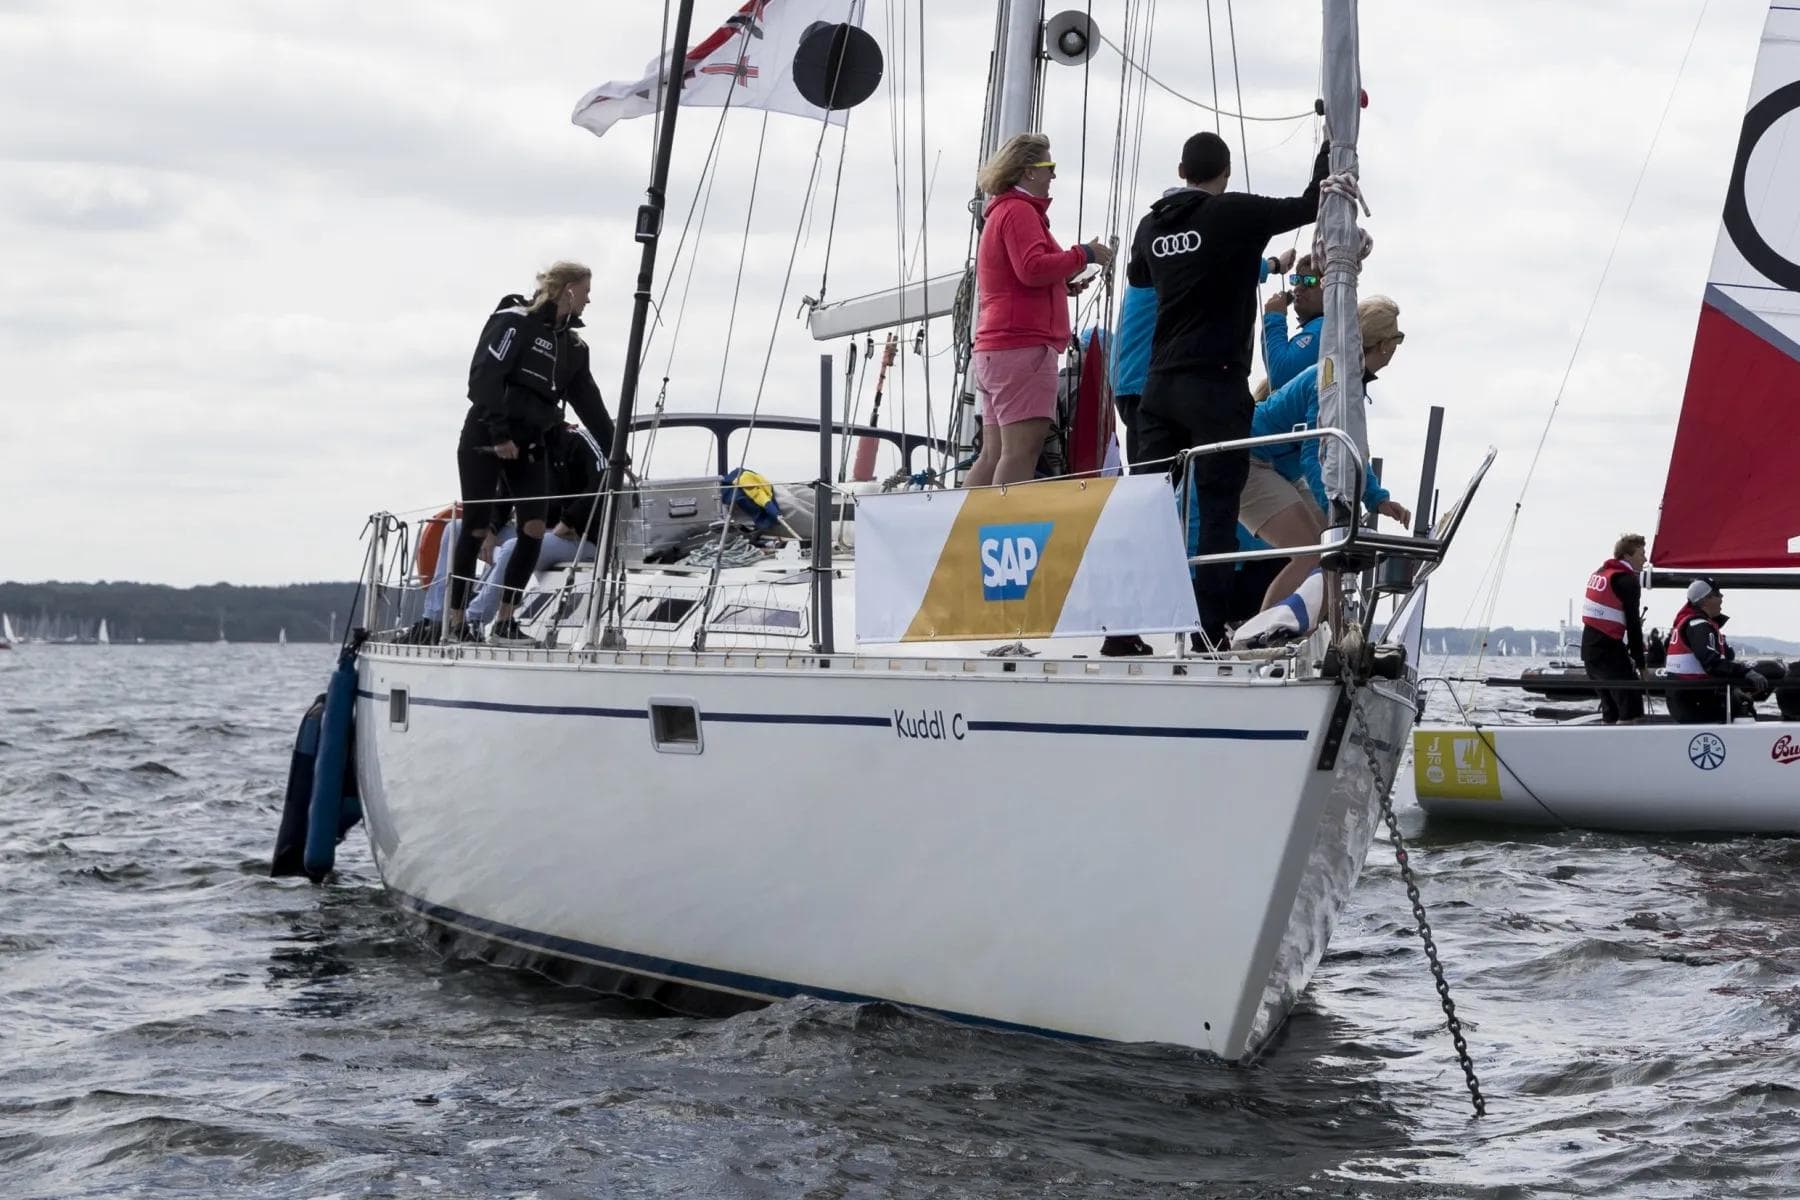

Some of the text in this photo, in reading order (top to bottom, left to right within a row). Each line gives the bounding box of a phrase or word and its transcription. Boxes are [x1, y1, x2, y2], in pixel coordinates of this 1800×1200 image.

[981, 537, 1038, 587] SAP
[894, 709, 965, 740] Kuddl C
